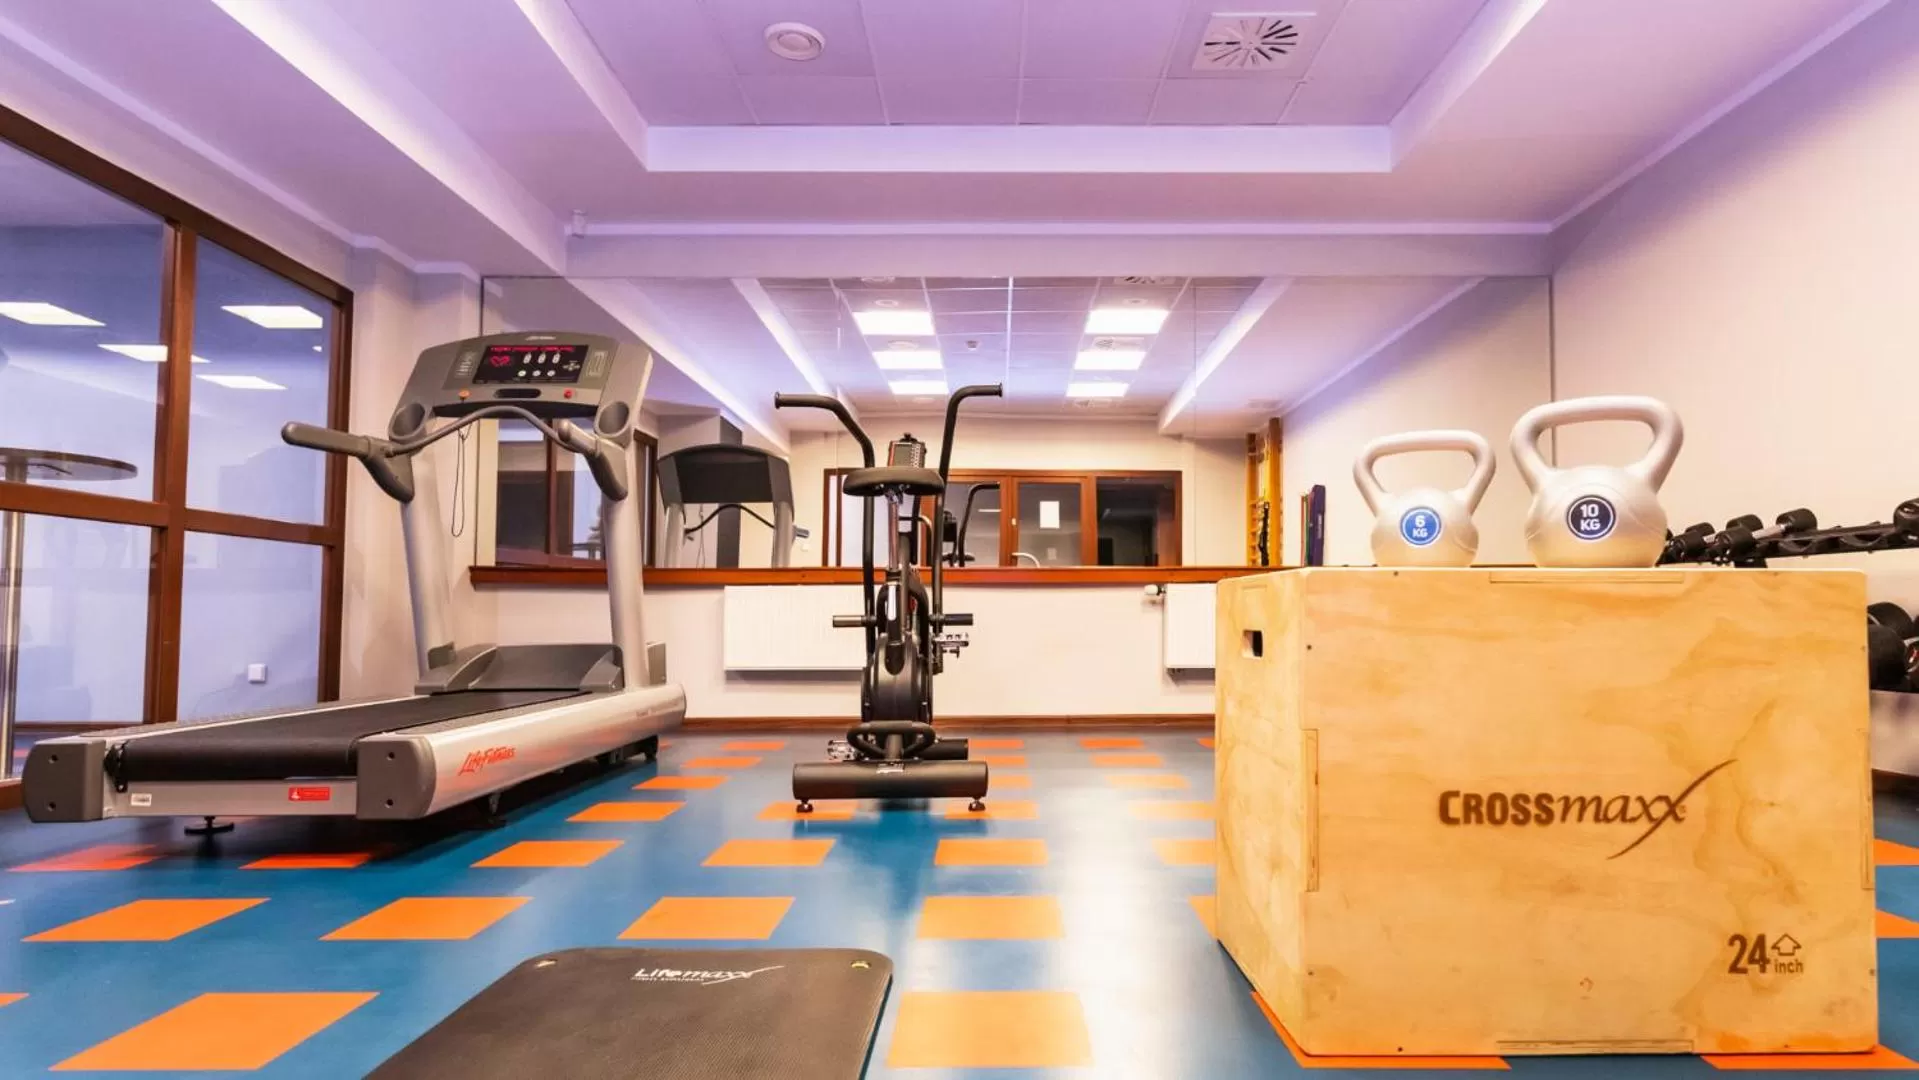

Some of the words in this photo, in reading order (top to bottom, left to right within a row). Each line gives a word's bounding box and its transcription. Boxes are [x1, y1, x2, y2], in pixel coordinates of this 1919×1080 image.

[1580, 504, 1599, 518] 10
[1415, 515, 1425, 528] 6
[1580, 519, 1600, 531] KG
[1412, 528, 1428, 538] KG
[1728, 933, 1771, 974] 24
[1774, 958, 1804, 974] inch
